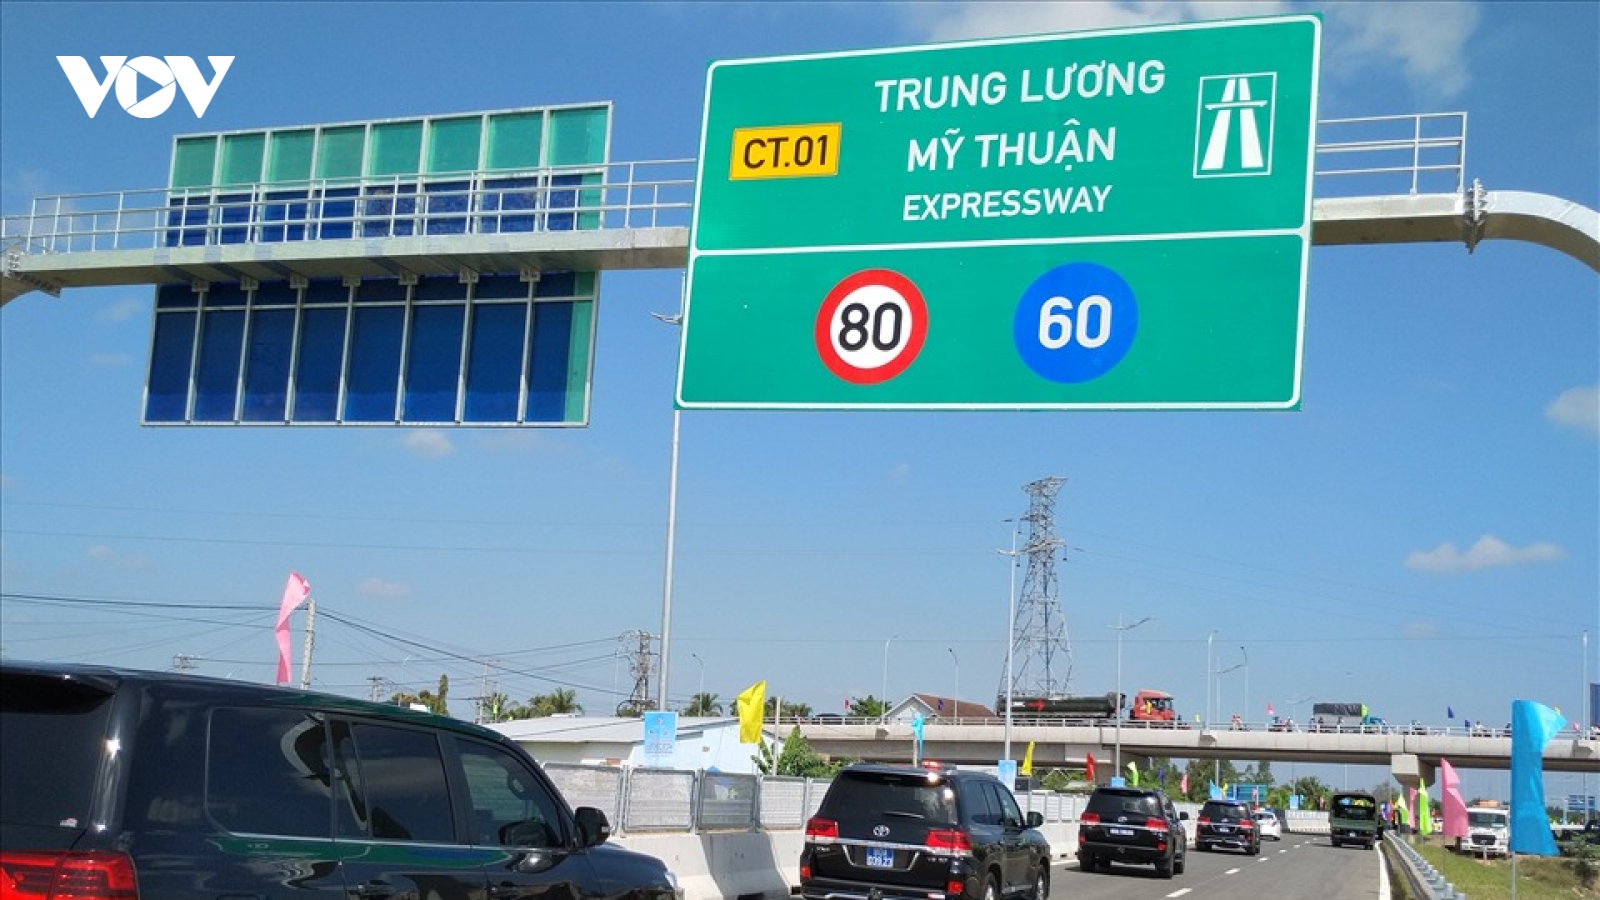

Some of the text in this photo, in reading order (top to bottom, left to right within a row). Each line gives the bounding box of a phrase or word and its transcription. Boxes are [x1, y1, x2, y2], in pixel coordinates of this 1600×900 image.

[875, 60, 1164, 112] TRUNG LƯƠNG
[745, 135, 827, 168] CT.01
[908, 119, 1115, 171] MỸ THUẬN
[904, 185, 1111, 220] EXPRESSWAY
[839, 303, 902, 350] 80
[1040, 295, 1111, 348] 60
